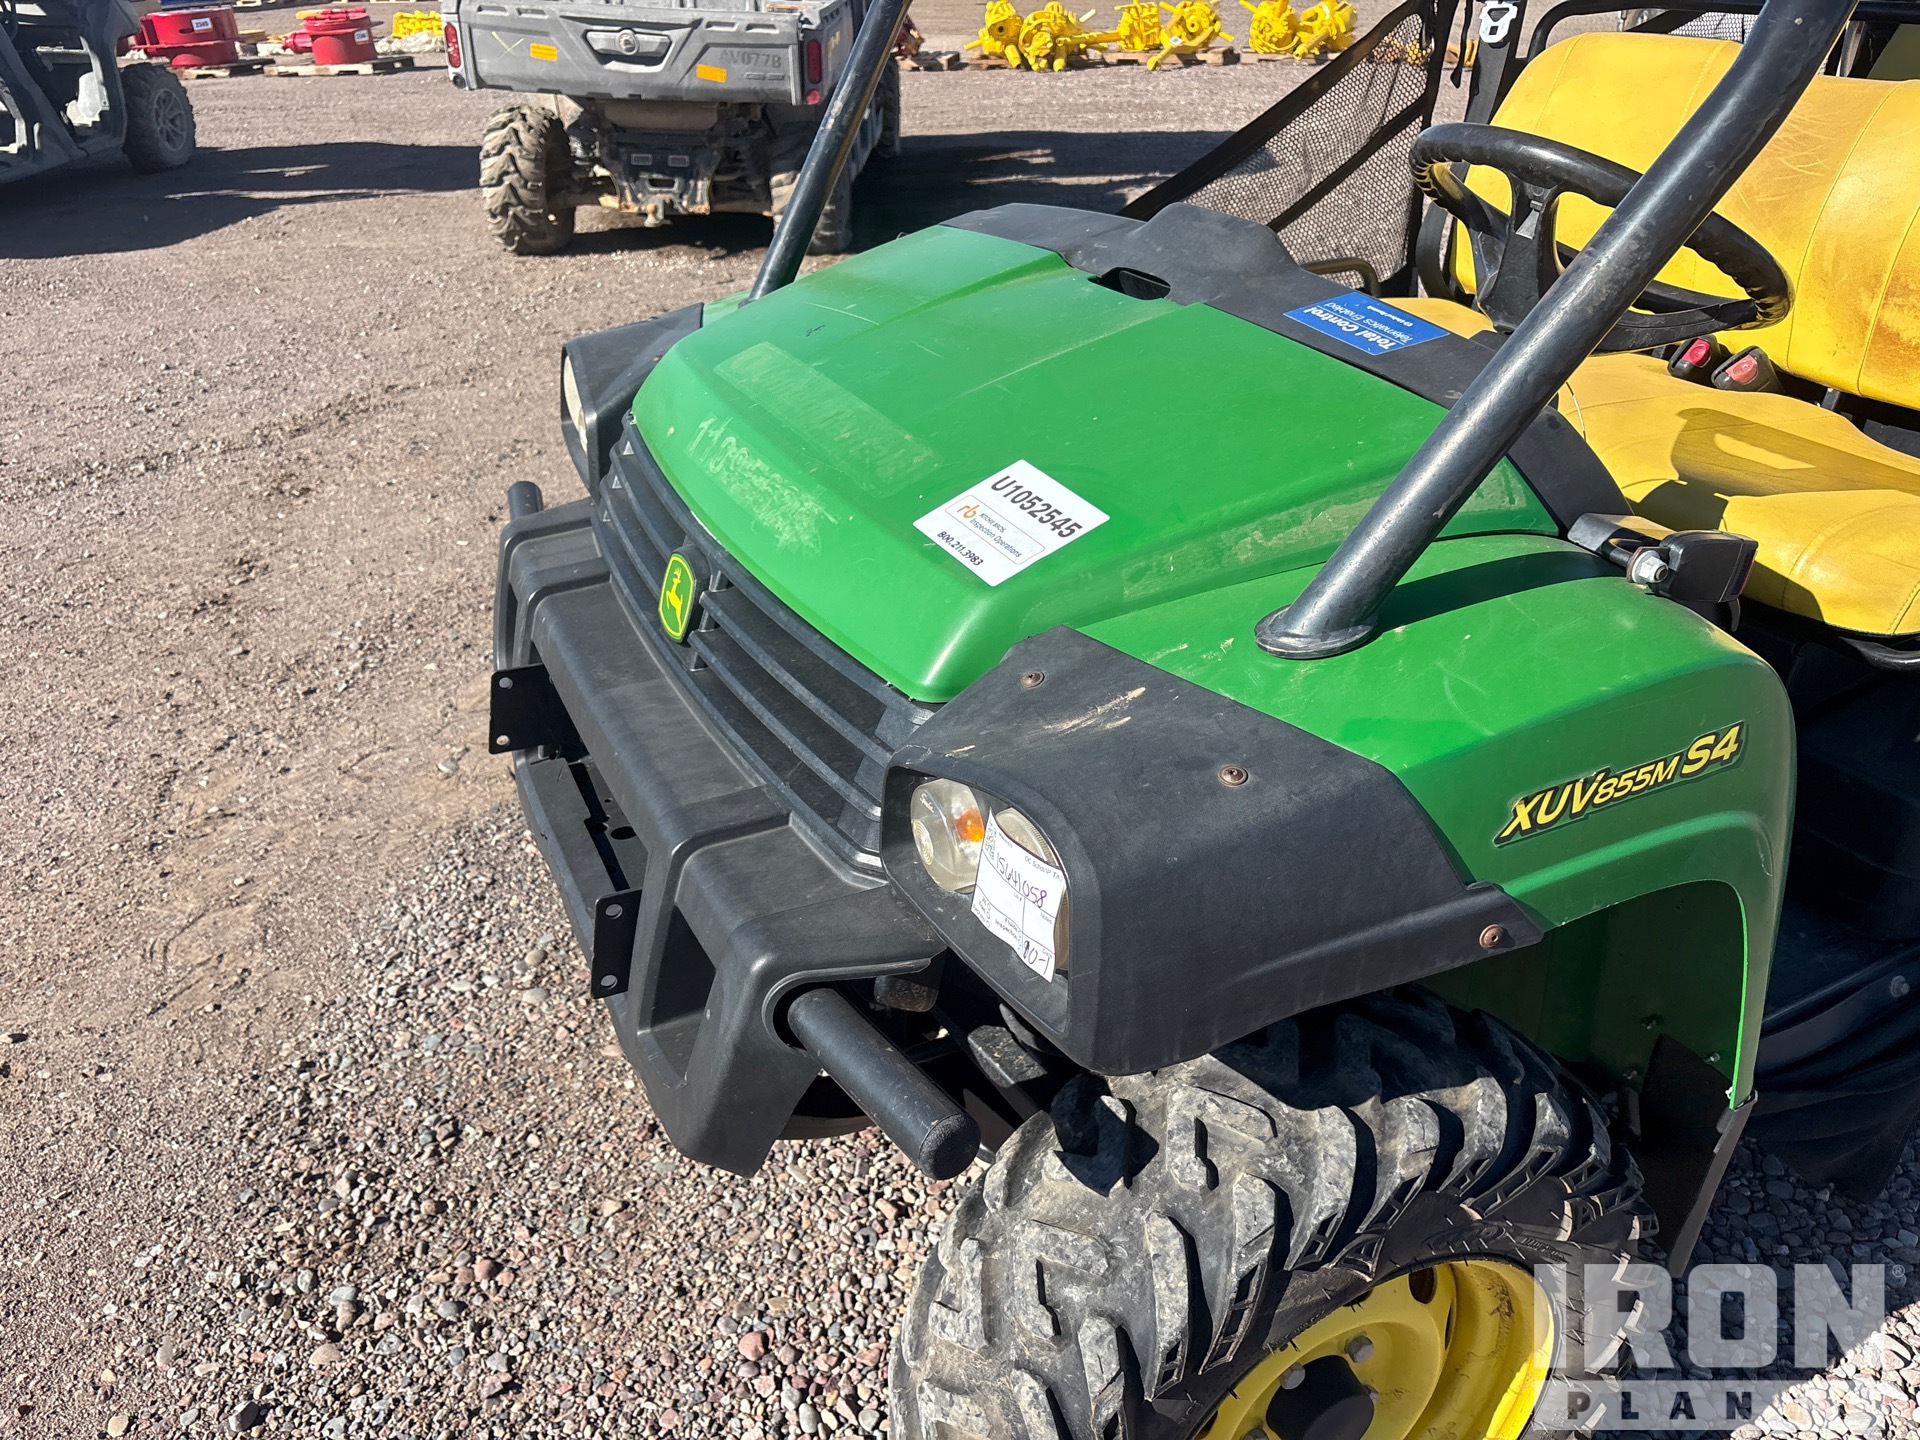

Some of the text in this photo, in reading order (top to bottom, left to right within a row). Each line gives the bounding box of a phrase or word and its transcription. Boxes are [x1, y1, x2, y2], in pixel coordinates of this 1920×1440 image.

[1303, 308, 1397, 350] Total Control
[1323, 302, 1414, 344] Telematics Enabled
[991, 475, 1083, 538] U1052545
[937, 530, 984, 566] 800.211.3983
[969, 517, 1023, 558] Inspection Operations
[1500, 725, 1740, 838] XUV855M S4
